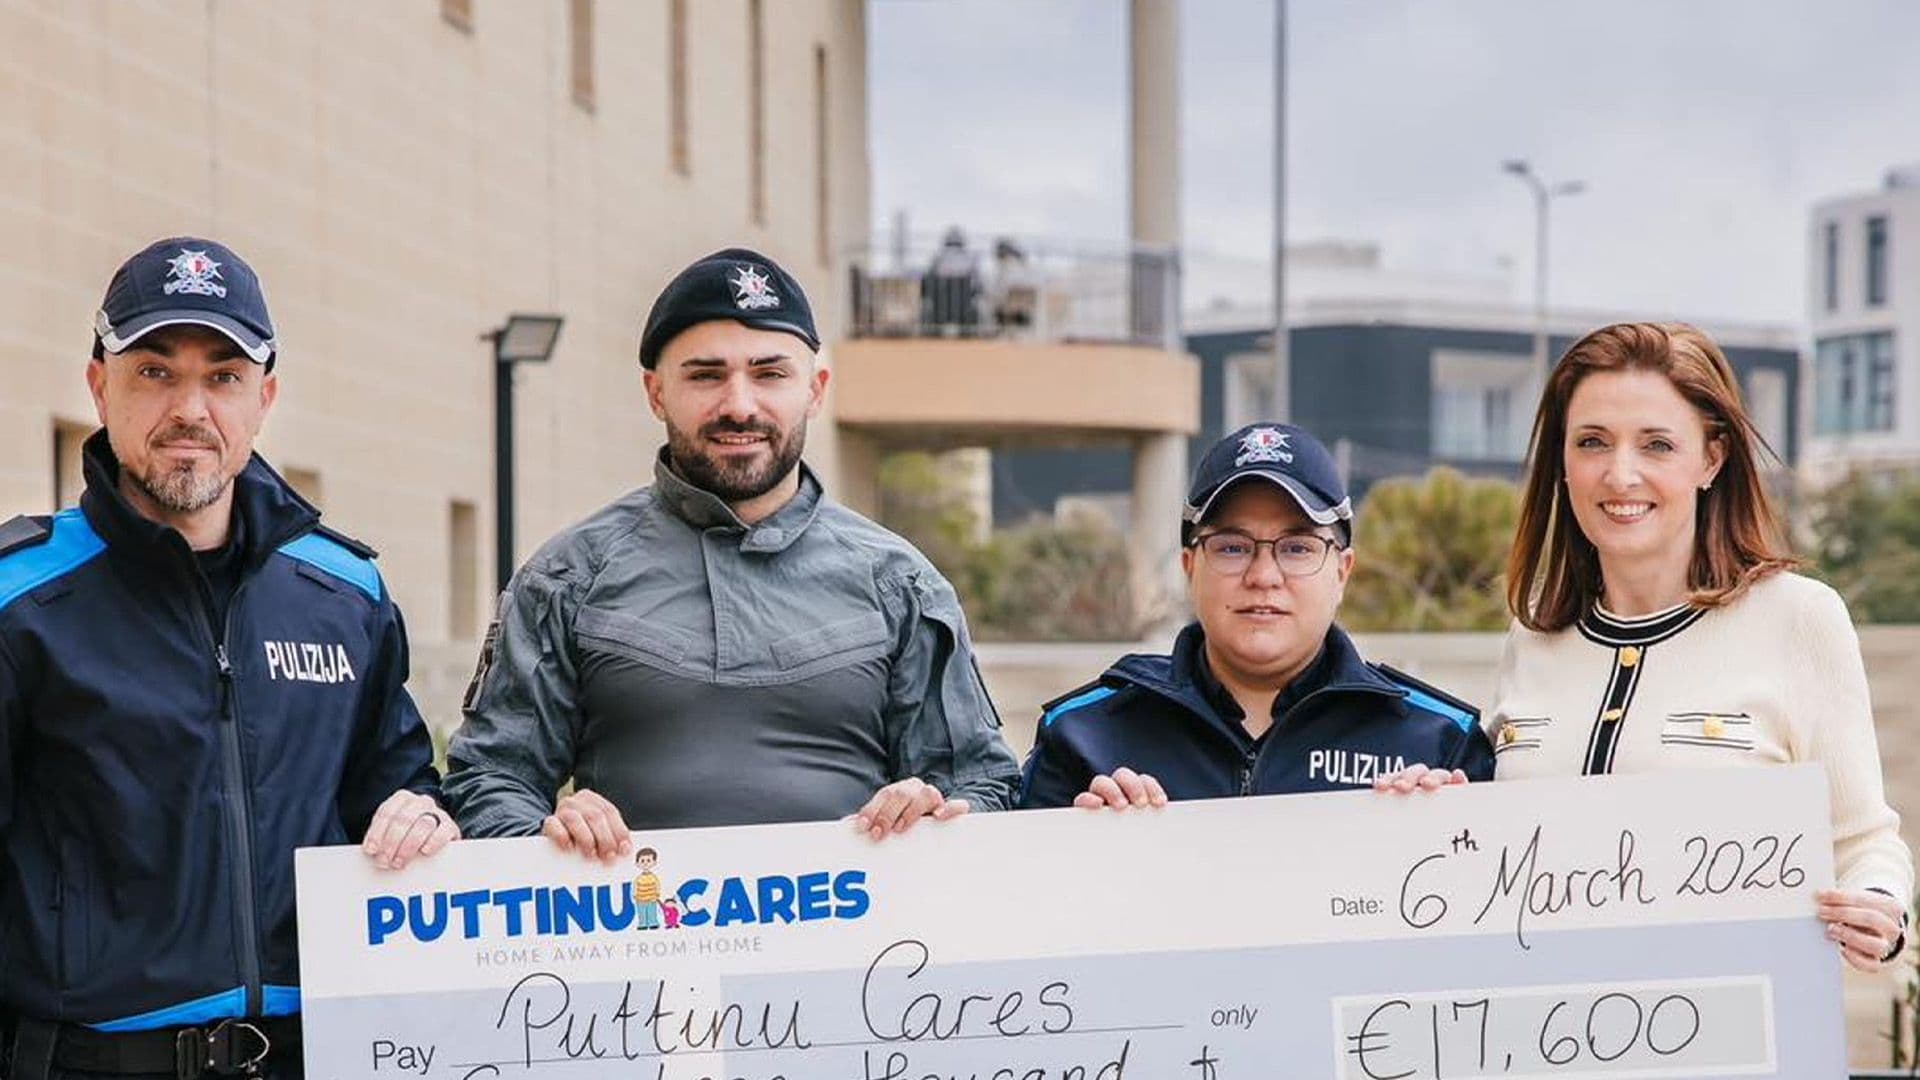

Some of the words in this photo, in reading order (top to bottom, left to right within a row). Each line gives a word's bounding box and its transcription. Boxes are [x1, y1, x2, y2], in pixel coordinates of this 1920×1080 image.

[264, 640, 356, 684] PULIZIJA
[367, 881, 635, 945] PUTTINU
[678, 870, 870, 927] CARES
[1330, 896, 1384, 918] Date:
[1473, 825, 1656, 950] March
[1676, 833, 1806, 897] 2026
[476, 948, 541, 967] HOME
[553, 945, 615, 962] AWAY
[626, 940, 688, 958] FROM
[699, 936, 763, 955] HOME
[372, 1040, 435, 1075] Pay
[497, 972, 812, 1069] Puttinu
[861, 939, 1074, 1042] Cares
[1210, 1004, 1258, 1031] only
